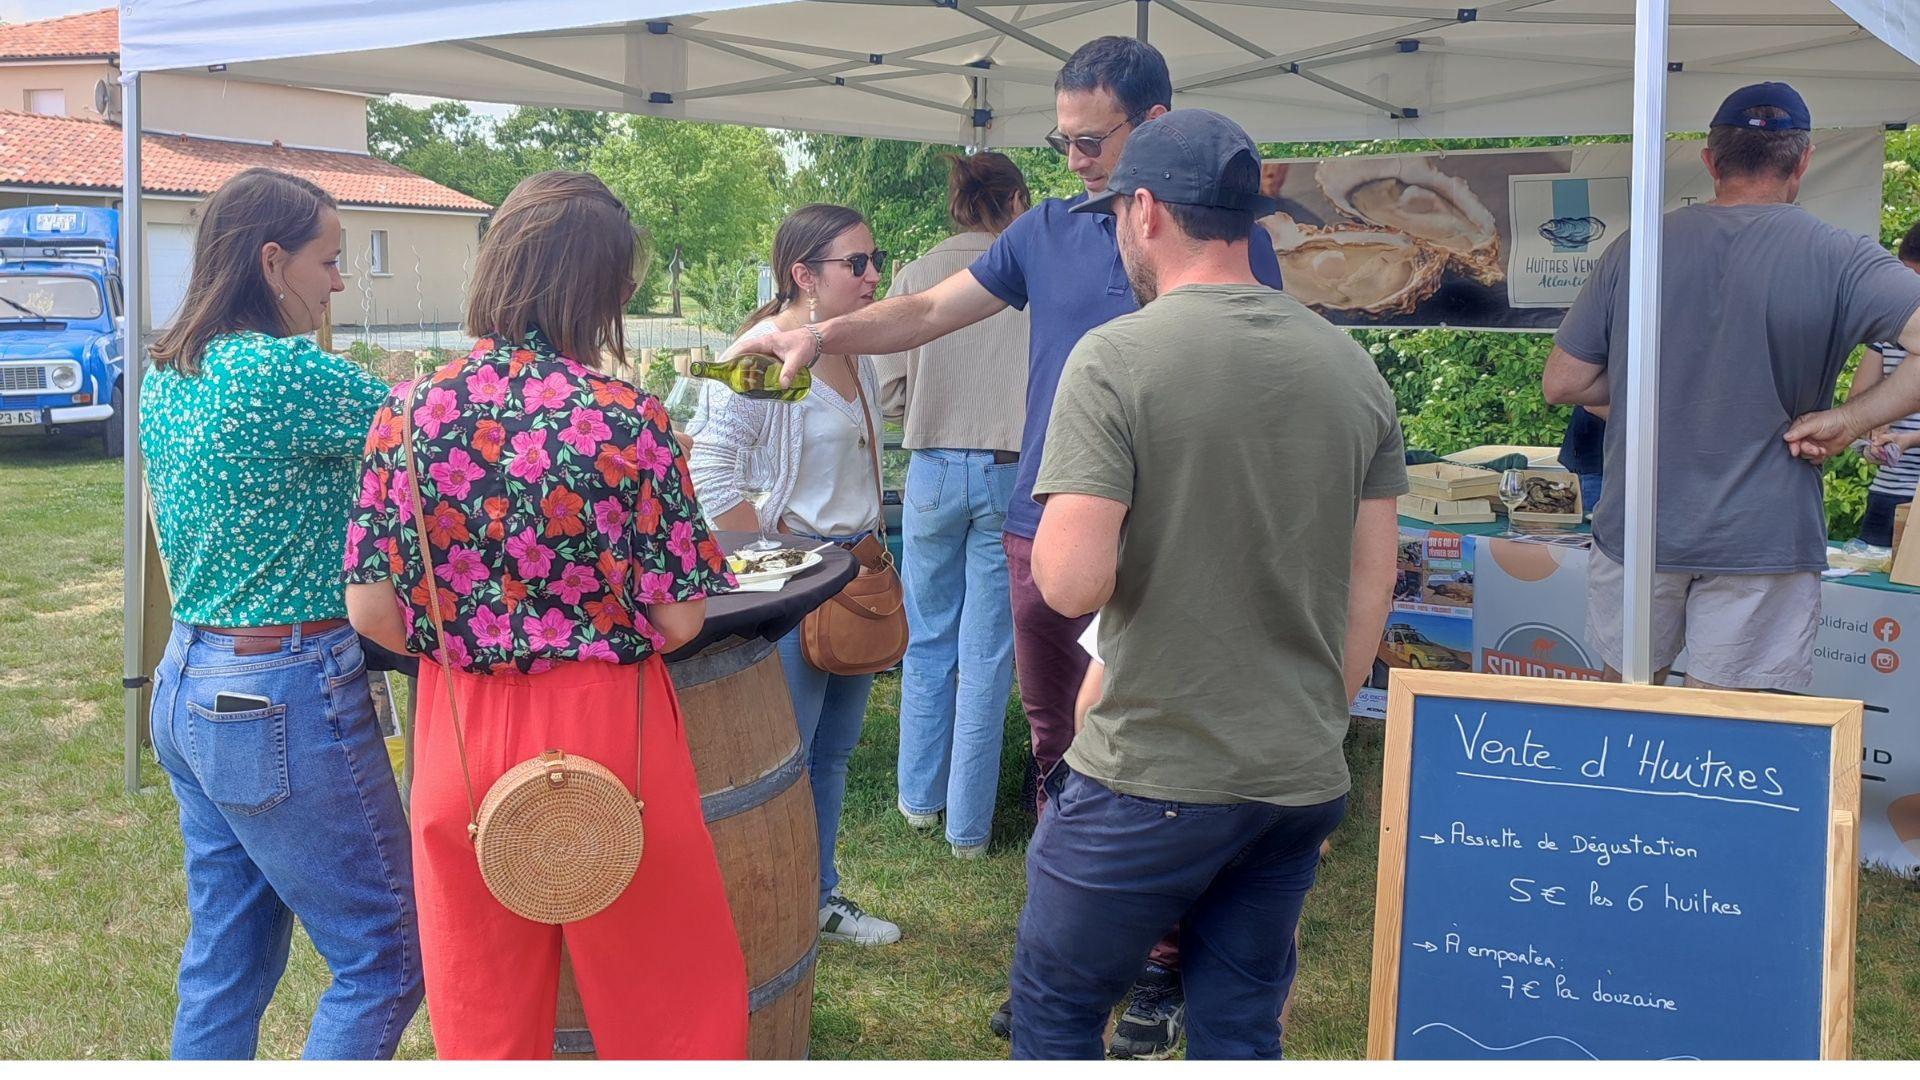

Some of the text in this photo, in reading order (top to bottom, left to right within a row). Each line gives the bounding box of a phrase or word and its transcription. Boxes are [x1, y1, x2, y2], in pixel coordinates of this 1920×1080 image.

[1814, 647, 1866, 664] olidraid
[1455, 712, 1562, 770] Vente
[1450, 821, 1698, 866] Assiette de Dégustation
[1589, 880, 1614, 906] les
[1627, 885, 1649, 912] 6
[1665, 883, 1742, 915] huitres
[1556, 974, 1580, 1000] la
[1592, 979, 1678, 1011] douzaine
